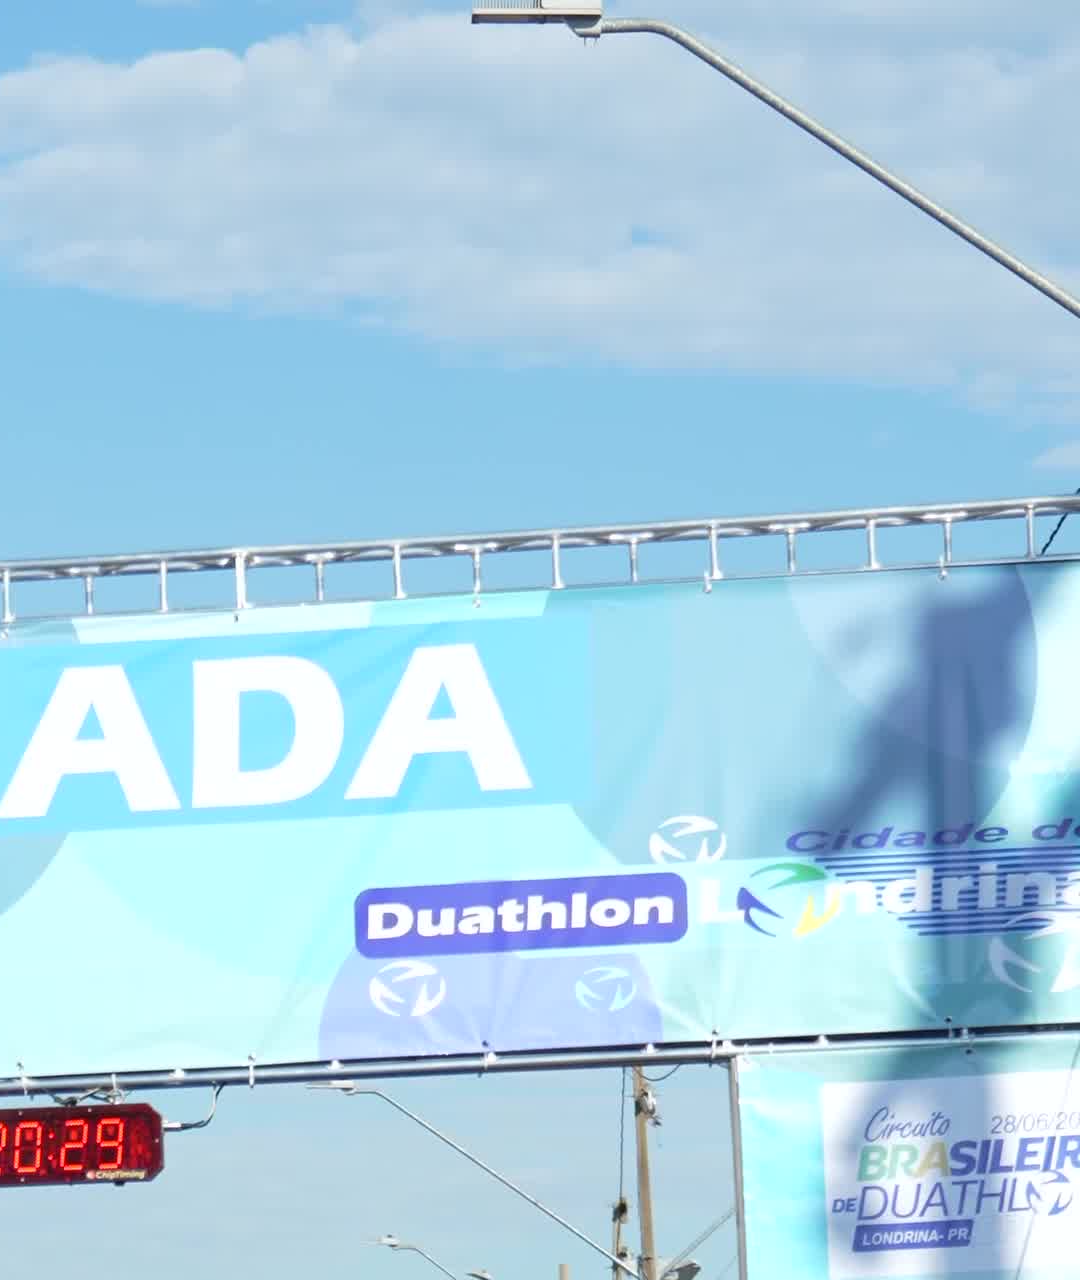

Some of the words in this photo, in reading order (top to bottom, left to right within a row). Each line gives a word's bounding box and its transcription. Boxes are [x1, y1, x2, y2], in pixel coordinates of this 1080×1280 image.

[785, 824, 1009, 852] Cidade
[1032, 819, 1080, 842] d
[366, 891, 674, 941] Duathlon
[864, 1106, 951, 1142] Circuito
[832, 1197, 857, 1214] DE
